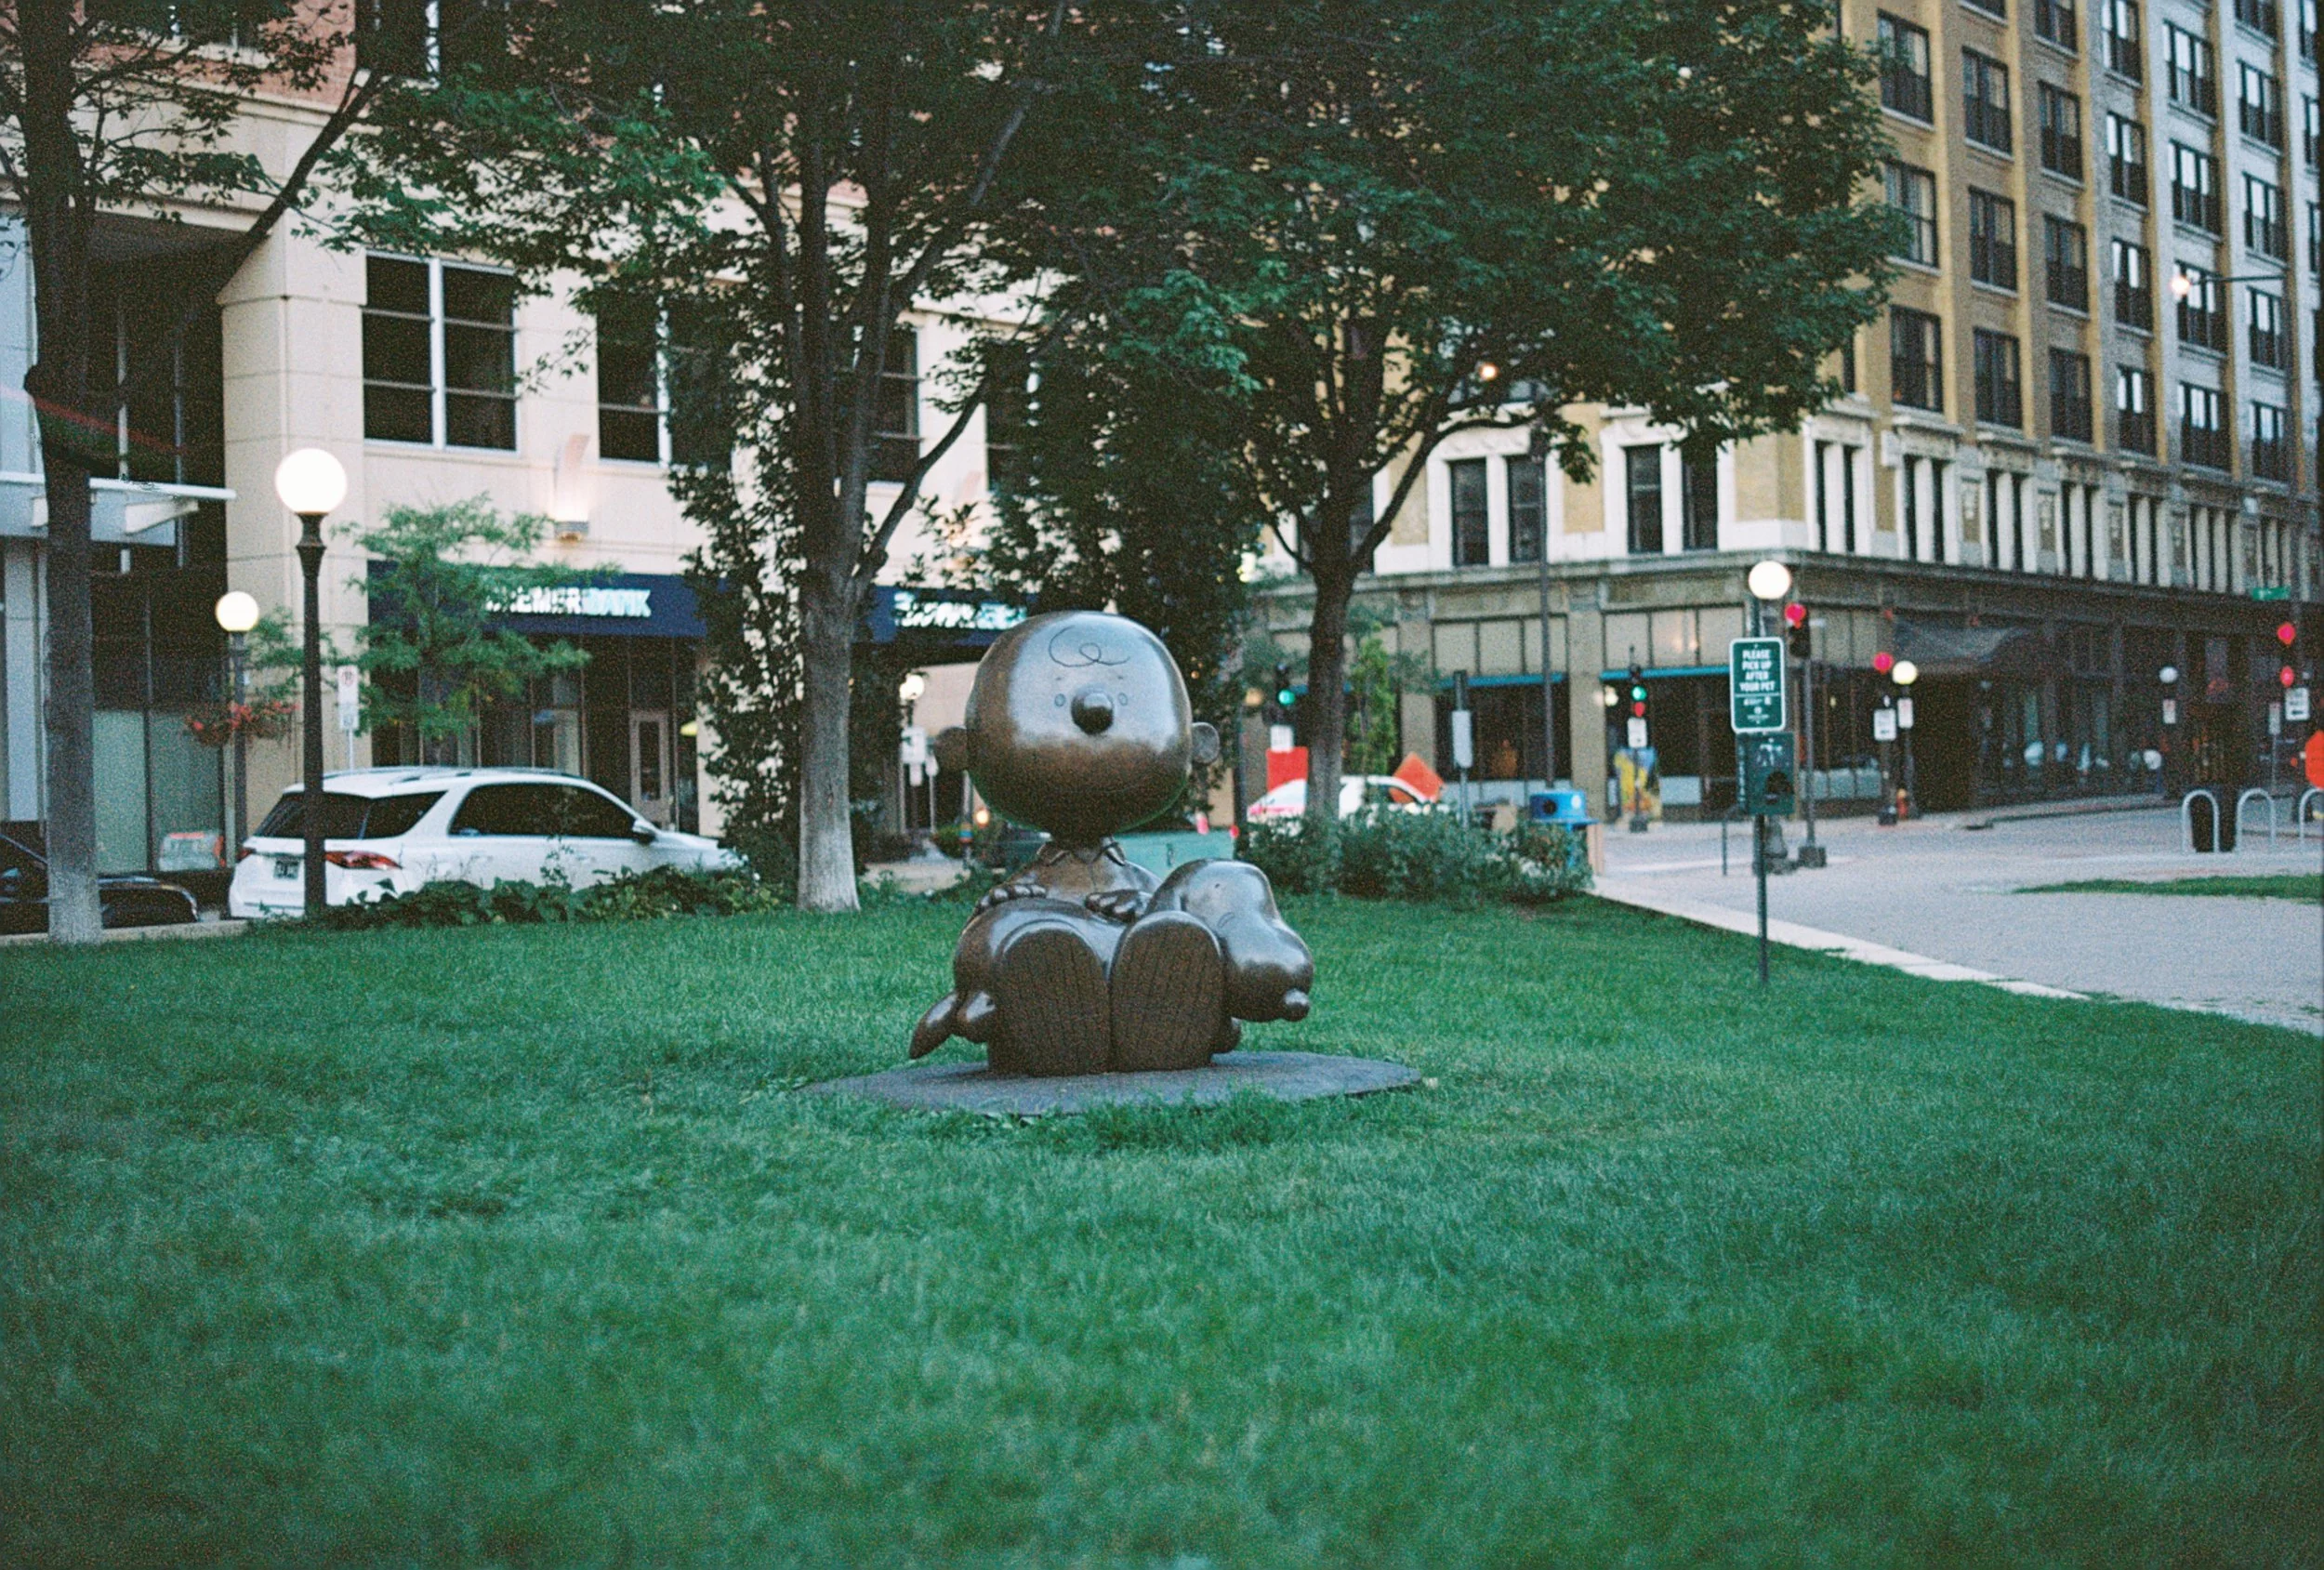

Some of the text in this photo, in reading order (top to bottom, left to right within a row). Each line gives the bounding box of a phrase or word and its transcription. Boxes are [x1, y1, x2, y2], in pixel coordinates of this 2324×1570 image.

[1742, 650, 1771, 660] PLEASE
[1741, 659, 1773, 670] PICK UP
[1746, 670, 1769, 680] AFTER
[1738, 680, 1776, 692] YOUR PET
